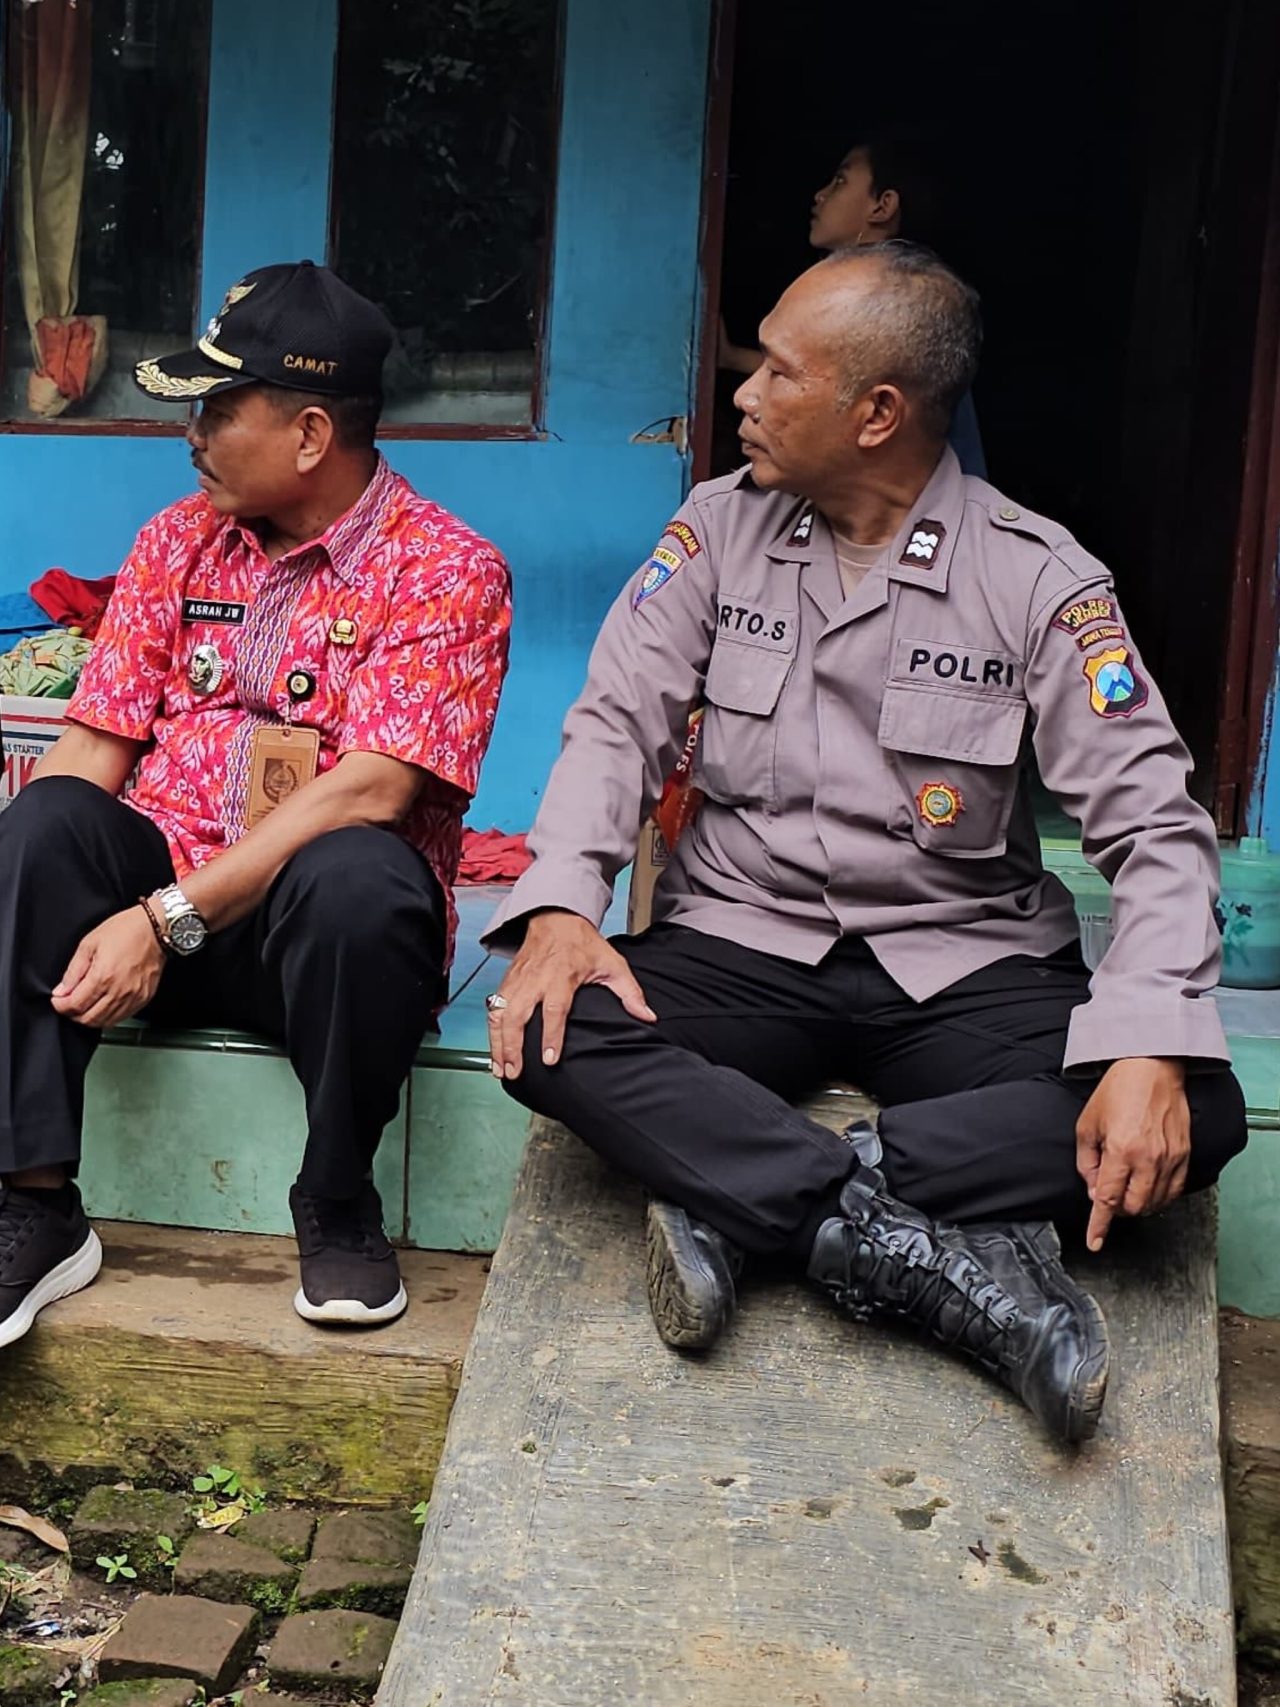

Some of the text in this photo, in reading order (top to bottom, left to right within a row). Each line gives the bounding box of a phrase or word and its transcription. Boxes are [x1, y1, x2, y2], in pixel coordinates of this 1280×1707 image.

[284, 353, 338, 376] CAMAT
[909, 648, 1014, 688] POLRI
[13, 744, 45, 756] STARTER
